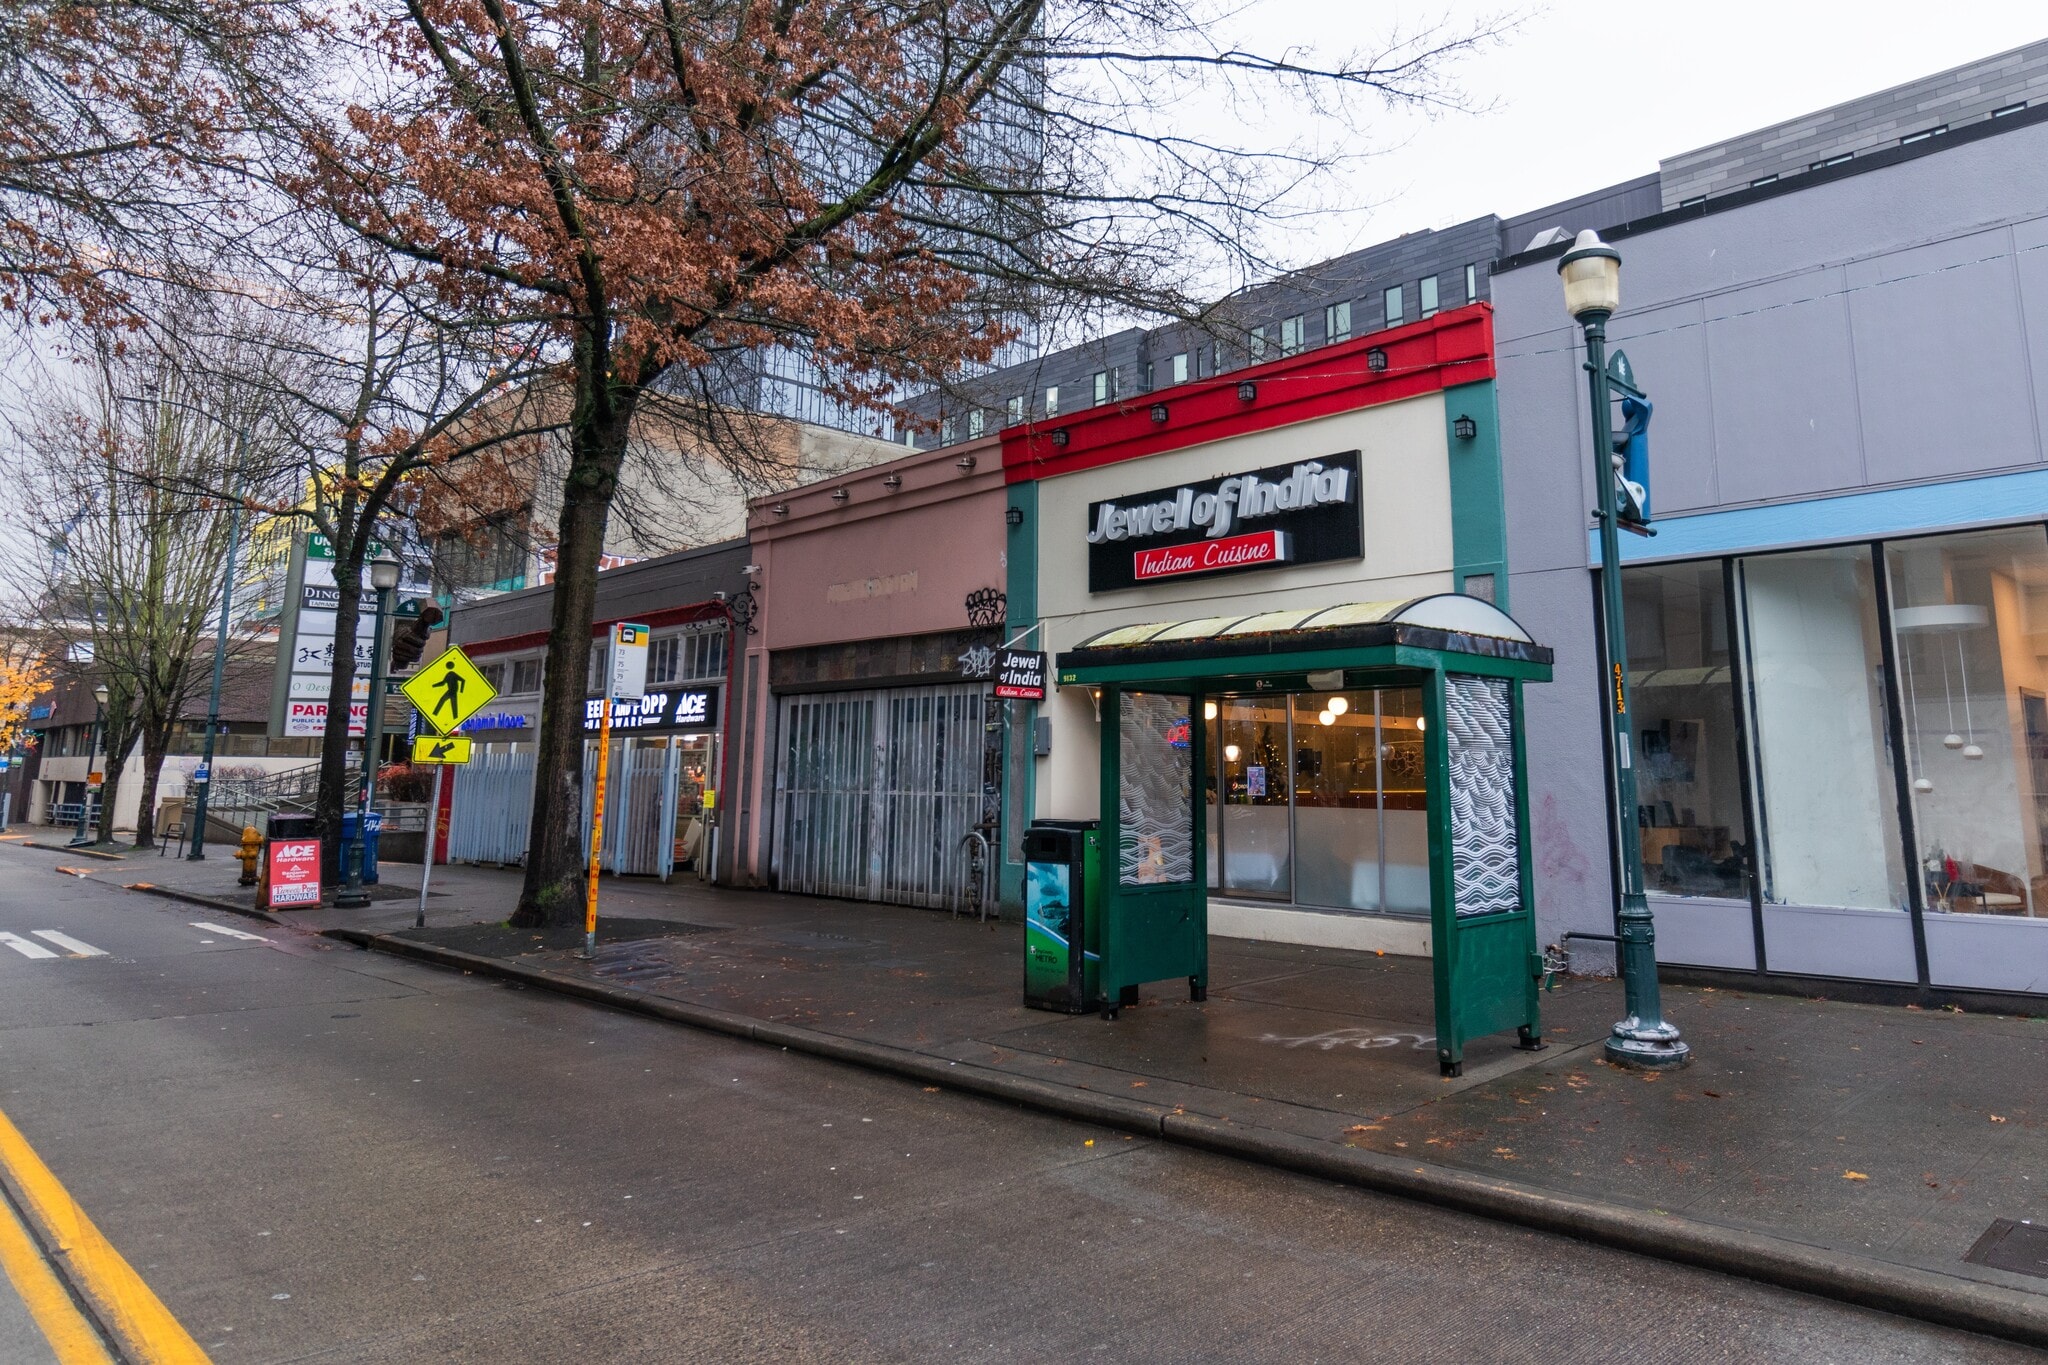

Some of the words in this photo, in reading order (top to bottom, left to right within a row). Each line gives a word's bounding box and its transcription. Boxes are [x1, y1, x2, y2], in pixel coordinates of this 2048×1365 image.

[1086, 488, 1193, 544] Jewel
[1191, 477, 1242, 538] of
[1237, 462, 1349, 519] India
[1142, 552, 1195, 575] Indian
[1203, 543, 1271, 566] Cuisine
[1002, 652, 1040, 670] Jewel
[999, 671, 1009, 683] of
[1008, 670, 1041, 686] India
[999, 687, 1018, 696] Indian
[1019, 688, 1040, 697] Cuisine
[1614, 663, 1625, 714] 4713
[292, 704, 369, 717] PARNG
[675, 692, 707, 714] ACE
[498, 712, 525, 728] Moore
[588, 715, 643, 730] HADWARE
[675, 714, 706, 723] Hardware
[276, 845, 315, 857] ACE
[274, 892, 317, 903] HARDWARE
